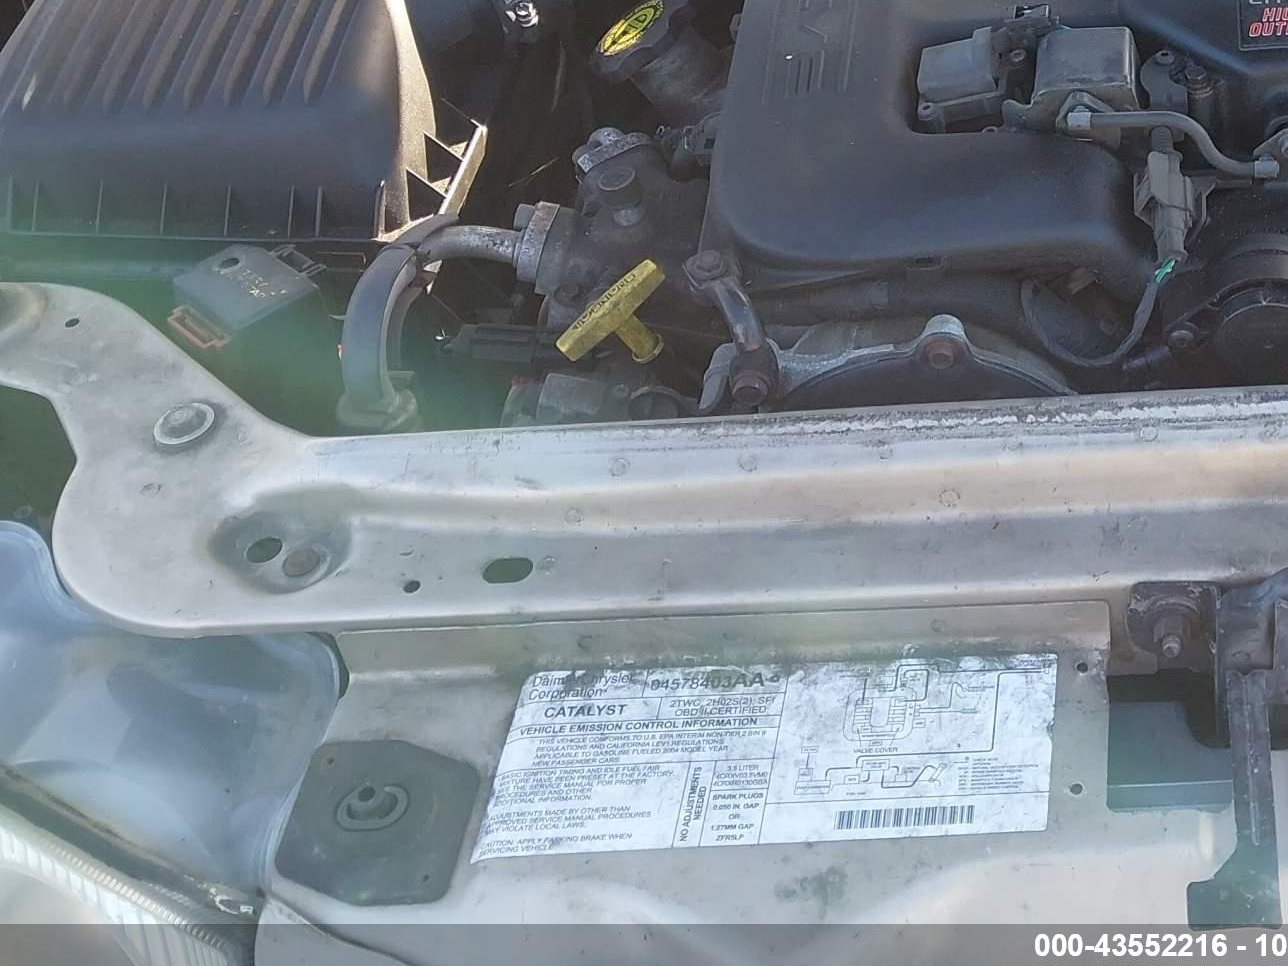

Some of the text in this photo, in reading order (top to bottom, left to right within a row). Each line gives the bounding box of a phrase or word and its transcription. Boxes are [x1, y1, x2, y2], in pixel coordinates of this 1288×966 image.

[544, 704, 628, 718] CATALYST
[674, 705, 767, 717] OBD CERTIFIED
[520, 717, 758, 736] VEHICLE EMISSION CONTROL INFORMATION
[588, 734, 630, 743] CONFORMS
[535, 745, 588, 753] REGULATIONS
[607, 741, 652, 750] CALIFORNIA
[672, 738, 725, 747] REGULATIONS
[875, 745, 898, 753] COVER
[534, 751, 578, 760] APPLICABLE
[593, 749, 630, 757] GASOLINE
[681, 745, 707, 753] MODEL
[552, 758, 597, 766] PASSENGER
[524, 770, 557, 778] IGNITION
[553, 775, 574, 783] BEEN
[529, 783, 561, 791] SERVICE
[563, 781, 594, 789] MANUAL
[615, 778, 648, 786] PROPER
[565, 787, 592, 796] OTHER
[680, 766, 702, 841] NO ADJUSTMENTS
[693, 786, 707, 820] NEEDED
[545, 809, 565, 817] MADE
[581, 806, 608, 814] OTHER
[529, 811, 652, 825] SERVICE MANUAL PROCEDURES
[502, 824, 533, 833] VIOLATE
[535, 822, 560, 830] LOCAL
[580, 834, 607, 842] BRAKE
